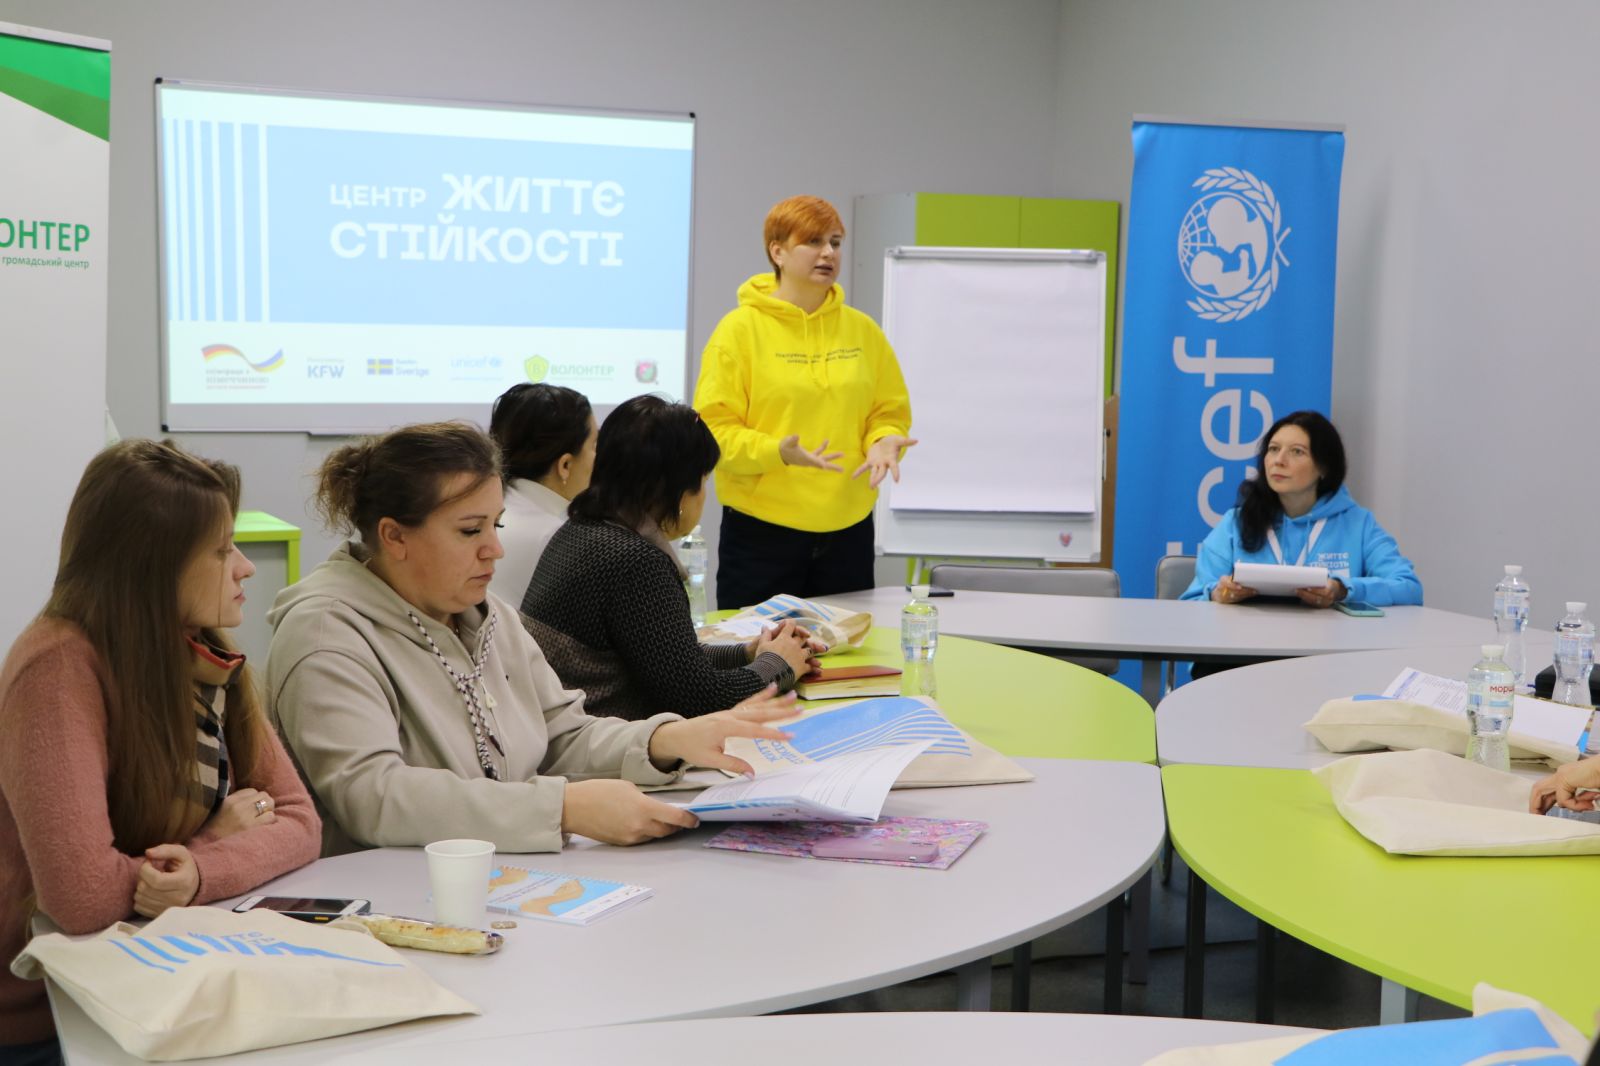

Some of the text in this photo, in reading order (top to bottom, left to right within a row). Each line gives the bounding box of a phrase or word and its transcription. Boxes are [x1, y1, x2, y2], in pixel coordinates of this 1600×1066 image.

[330, 173, 625, 217] ЦЕНТР ЖИТТЄ
[330, 213, 624, 267] СТІЙКОСТІ
[2, 257, 89, 269] громадський центр
[307, 365, 344, 379] KFW
[550, 364, 615, 376] ВОЛОНТЕР
